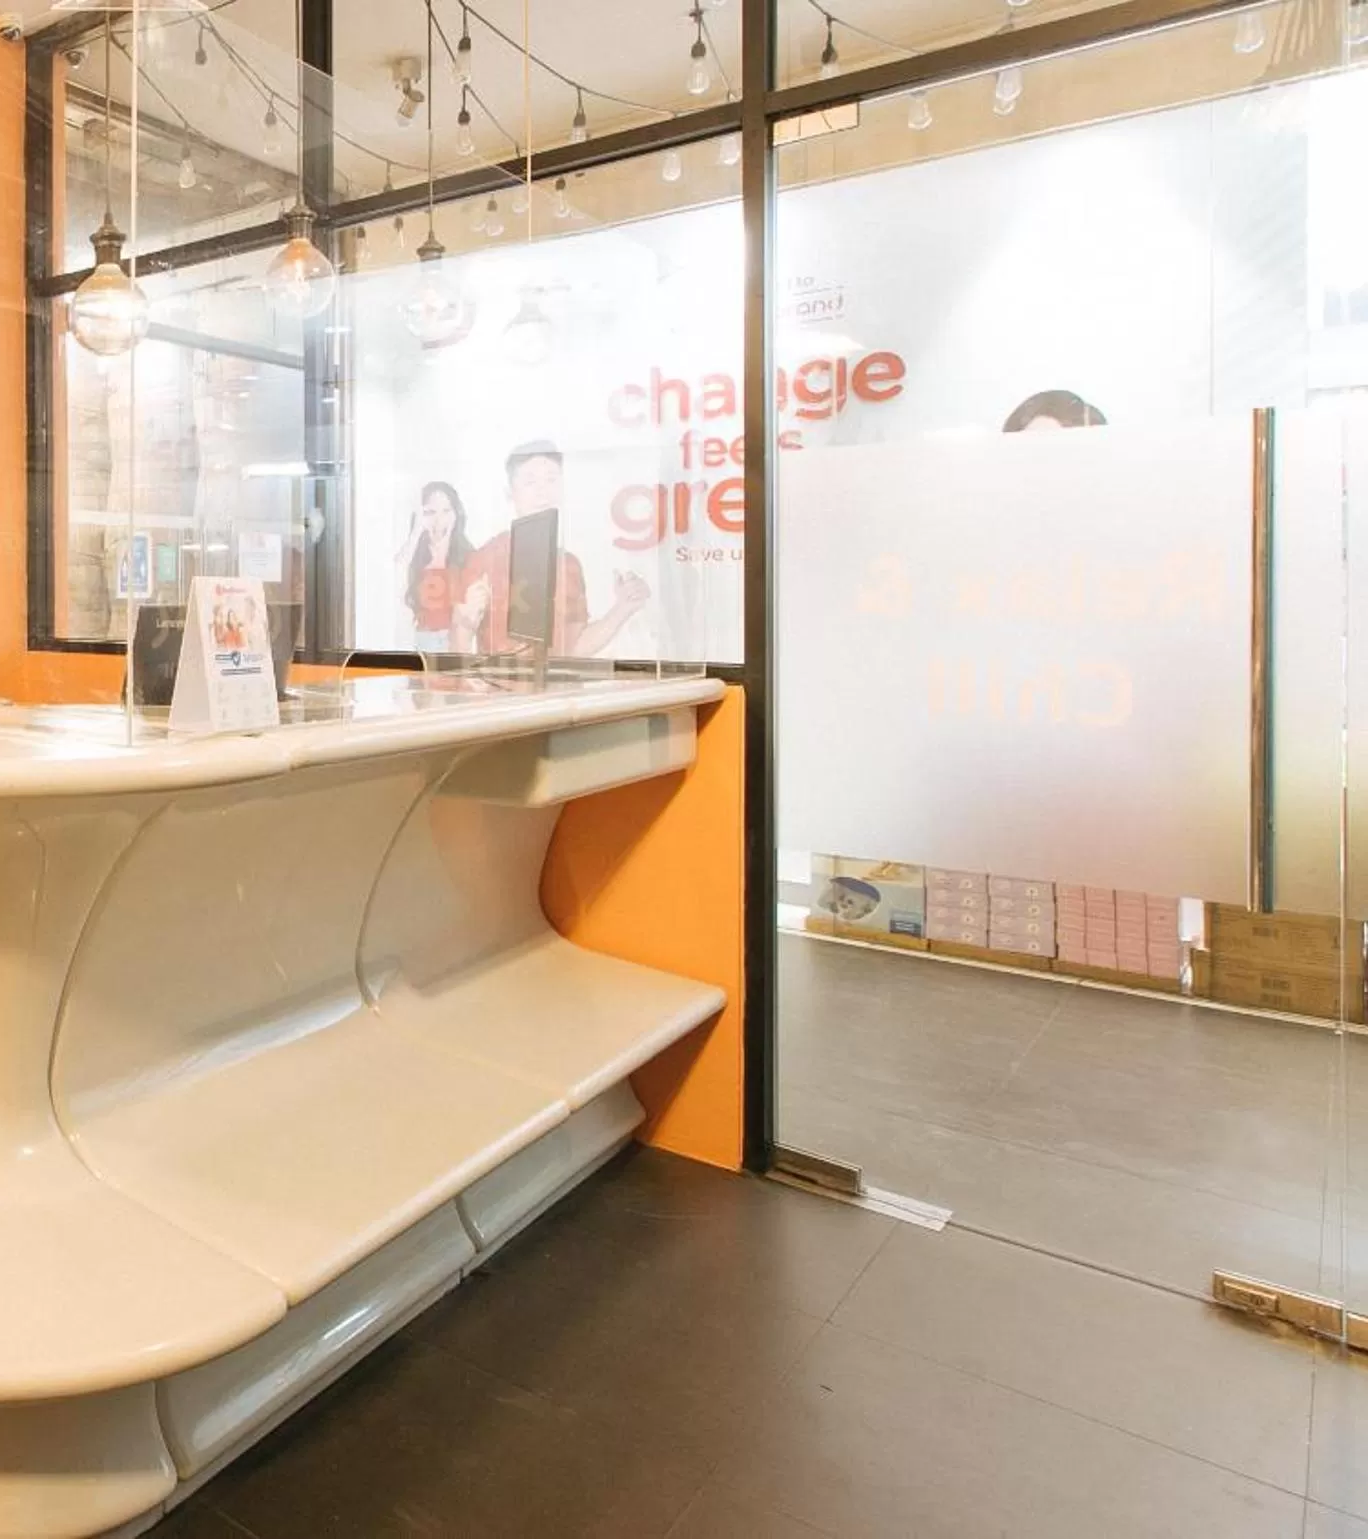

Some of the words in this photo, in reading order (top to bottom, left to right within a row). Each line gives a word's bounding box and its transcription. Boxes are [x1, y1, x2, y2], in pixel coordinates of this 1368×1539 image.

[607, 350, 906, 429] chage
[679, 429, 804, 470] fees
[610, 476, 744, 551] gre
